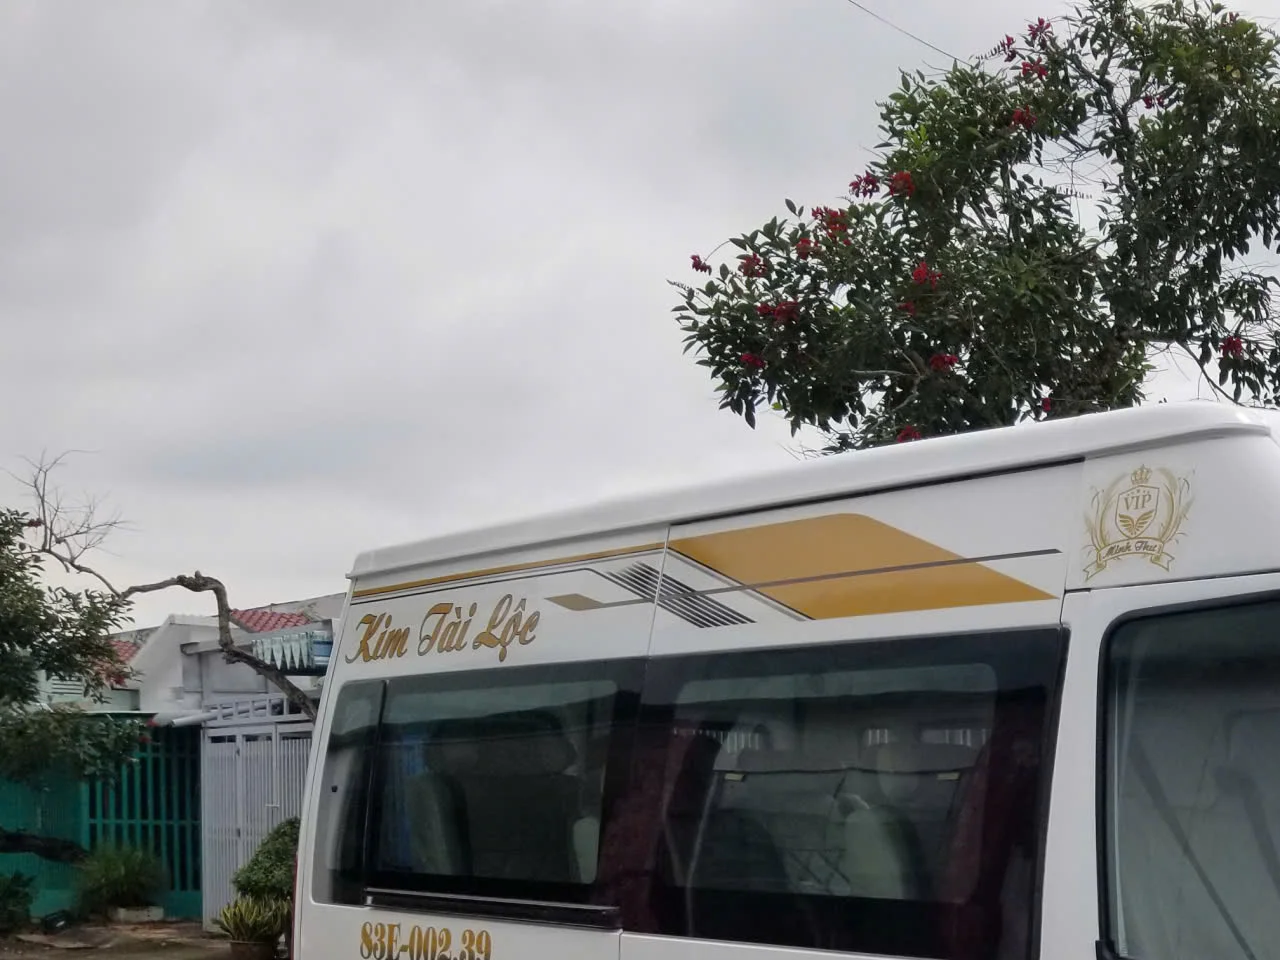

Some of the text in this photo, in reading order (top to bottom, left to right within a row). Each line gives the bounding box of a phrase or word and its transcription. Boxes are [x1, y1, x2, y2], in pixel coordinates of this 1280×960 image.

[1124, 494, 1151, 511] VIP
[345, 594, 541, 664] Kim Tài Lộc
